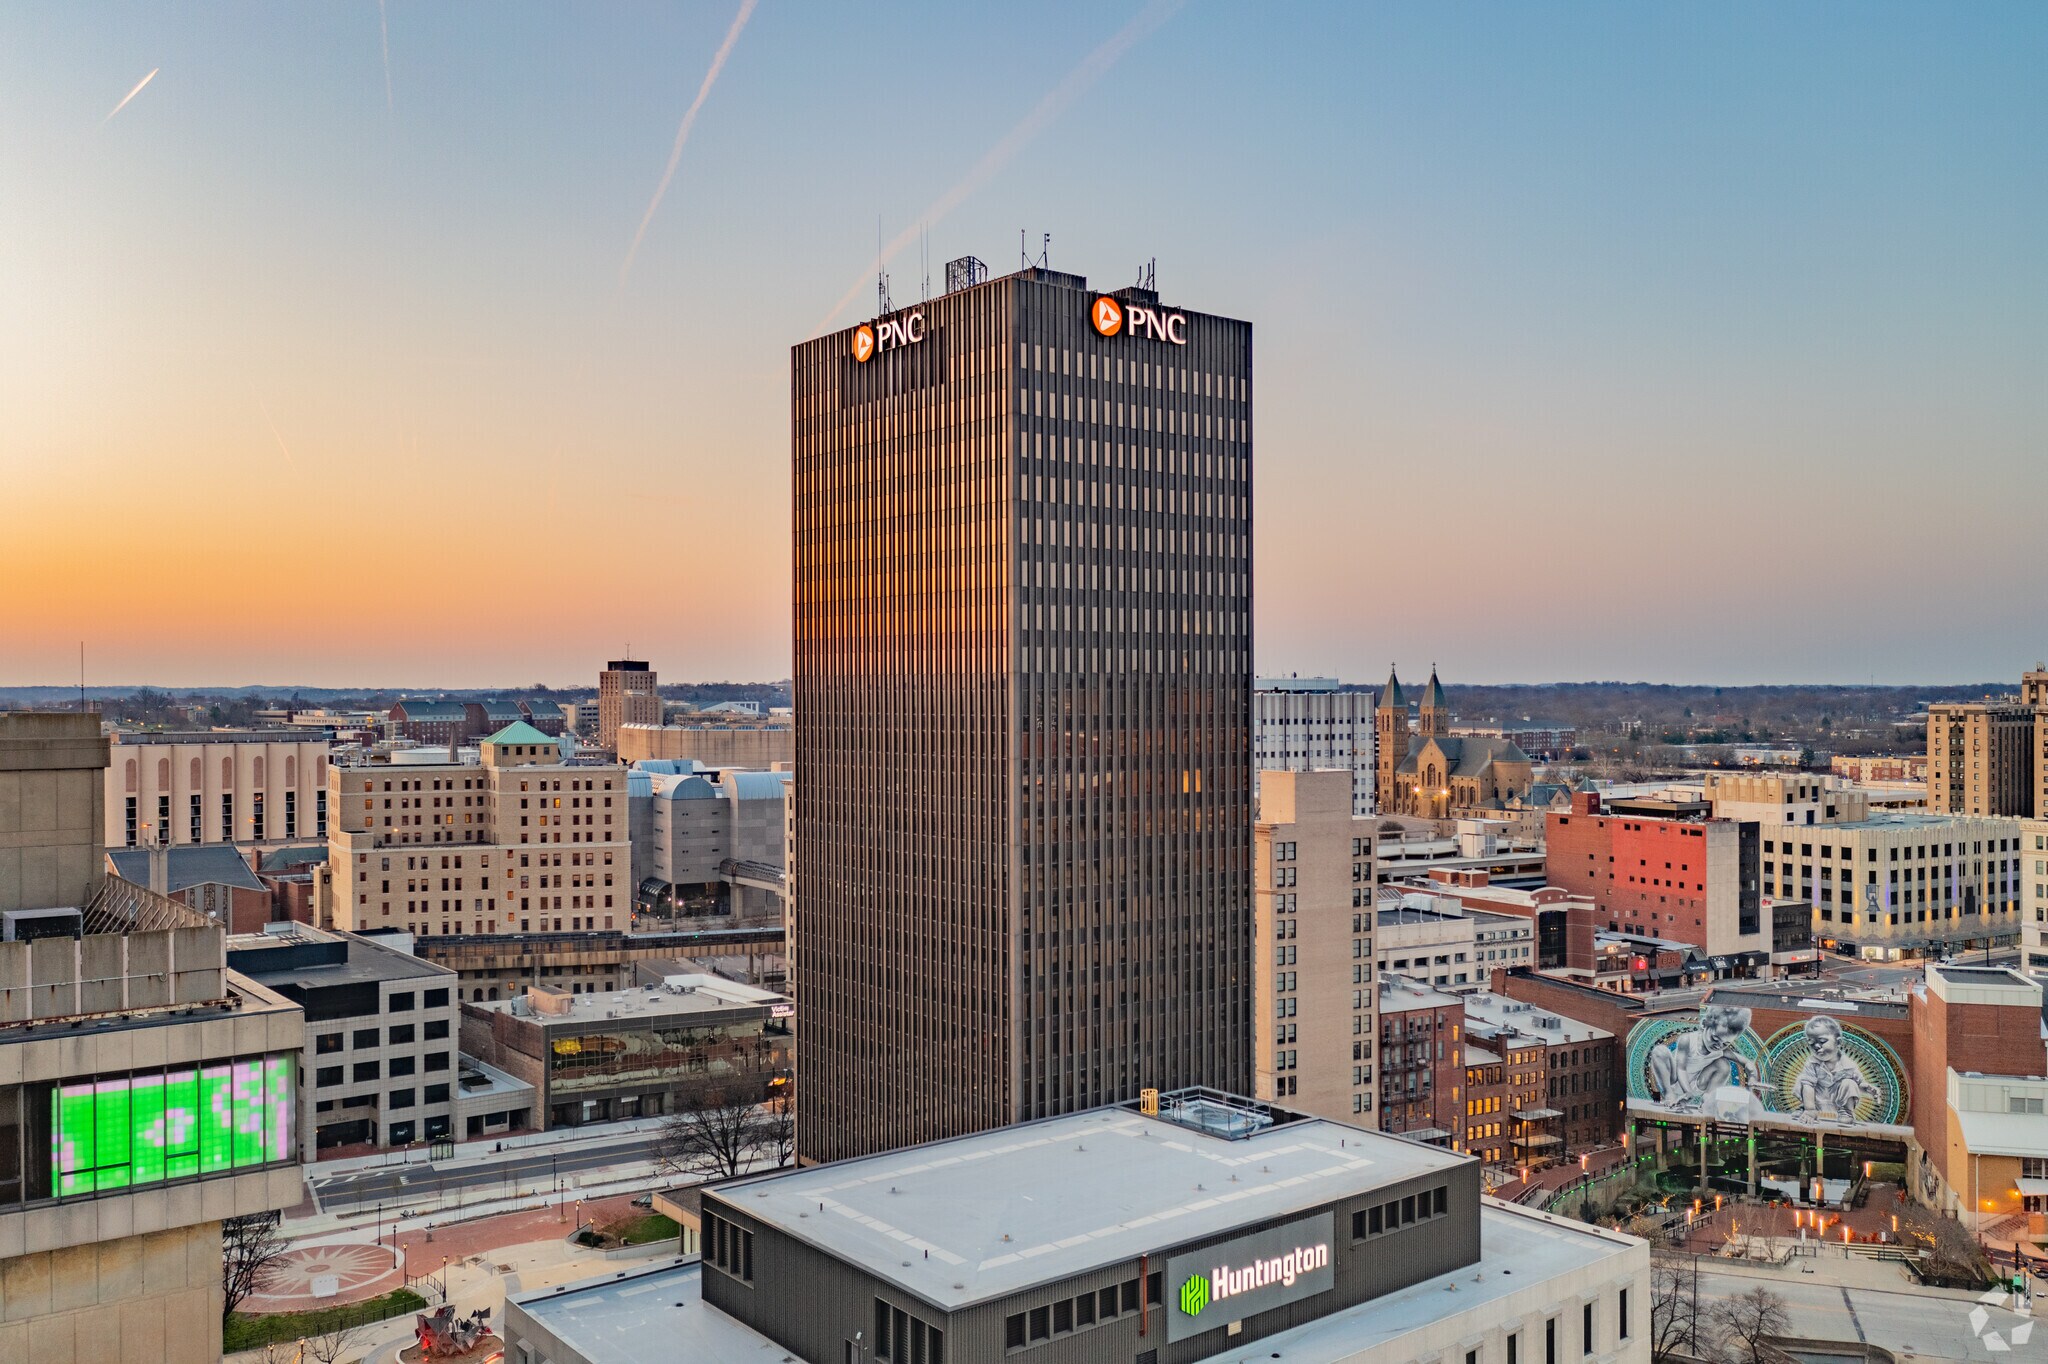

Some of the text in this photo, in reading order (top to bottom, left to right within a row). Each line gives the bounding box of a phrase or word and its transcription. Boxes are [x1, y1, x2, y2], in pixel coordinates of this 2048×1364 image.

[877, 313, 923, 352] PNC
[1126, 305, 1186, 345] PNC
[1211, 1243, 1328, 1301] Huntington
